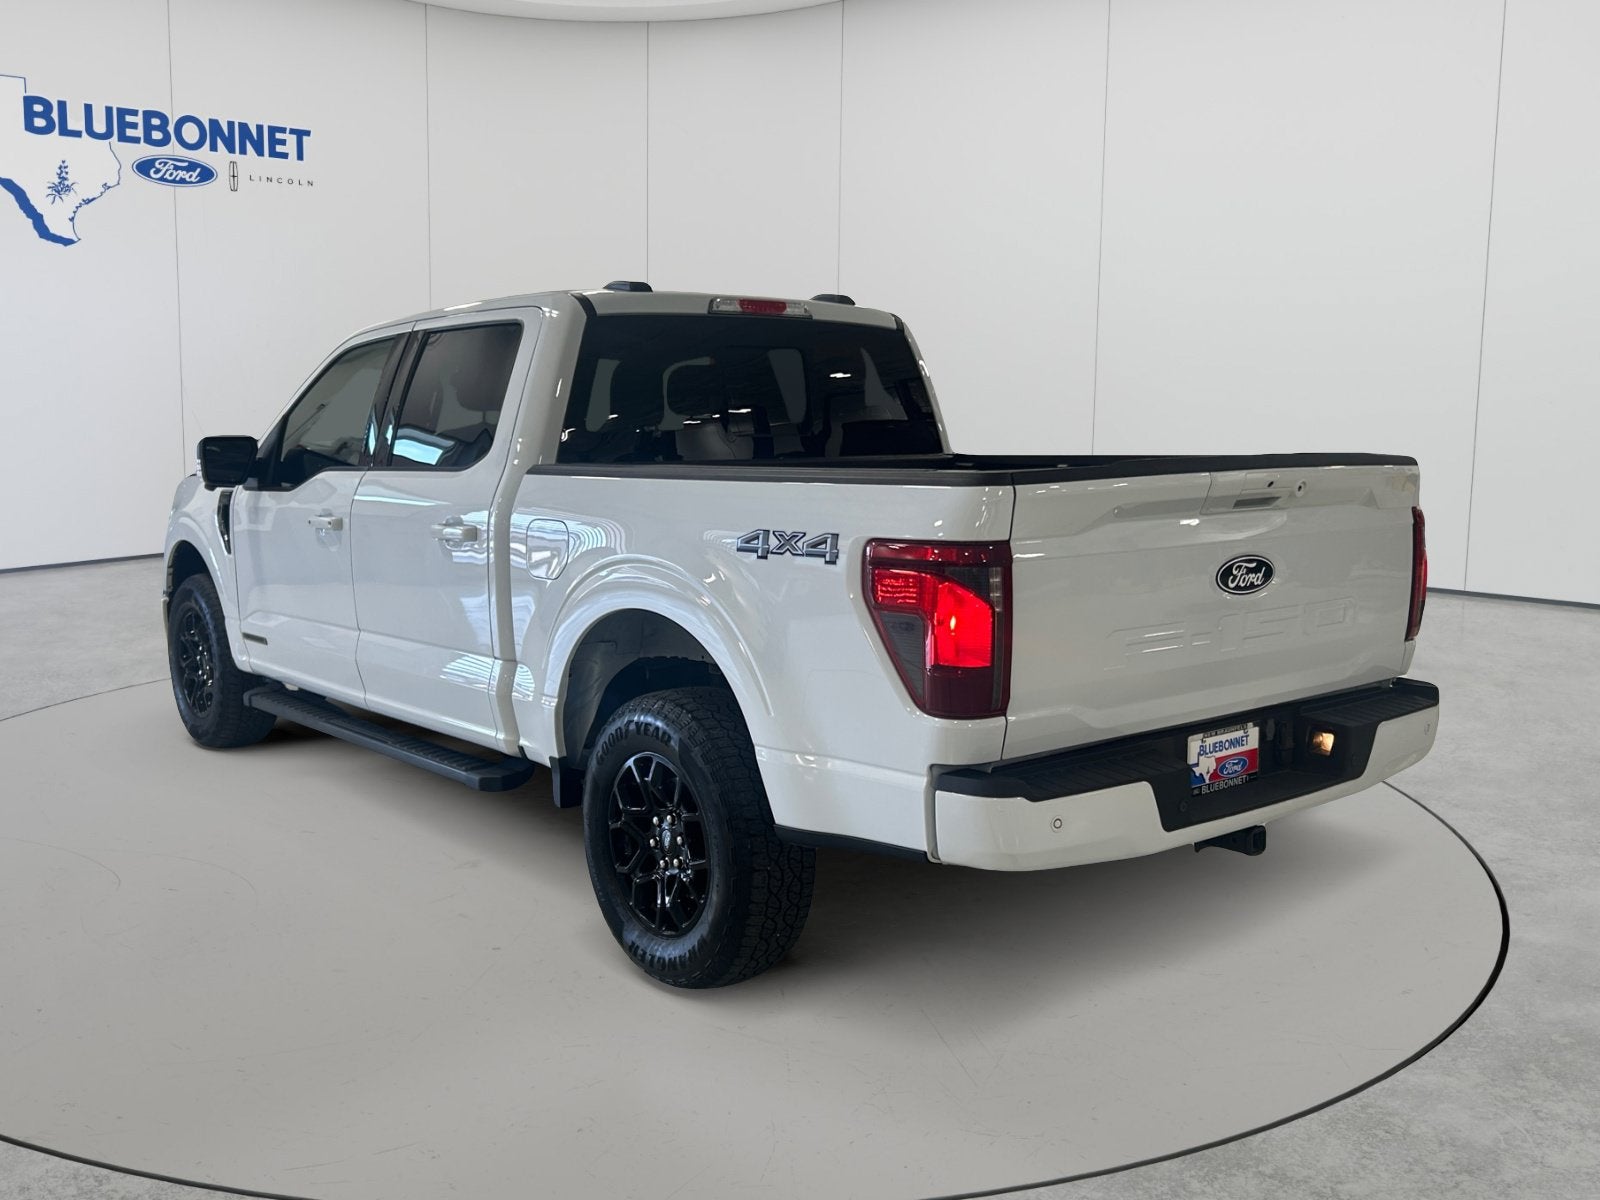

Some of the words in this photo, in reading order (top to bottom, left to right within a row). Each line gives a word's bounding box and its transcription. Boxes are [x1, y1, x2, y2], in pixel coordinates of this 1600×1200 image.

[23, 95, 311, 161] BLUEBONNET
[149, 158, 200, 184] Ford
[249, 174, 314, 187] LINCOLN
[1228, 561, 1266, 588] Ford
[1199, 734, 1249, 756] BLUEBONNET
[1223, 760, 1243, 775] Ford
[1201, 775, 1247, 794] BLUEBONNET
